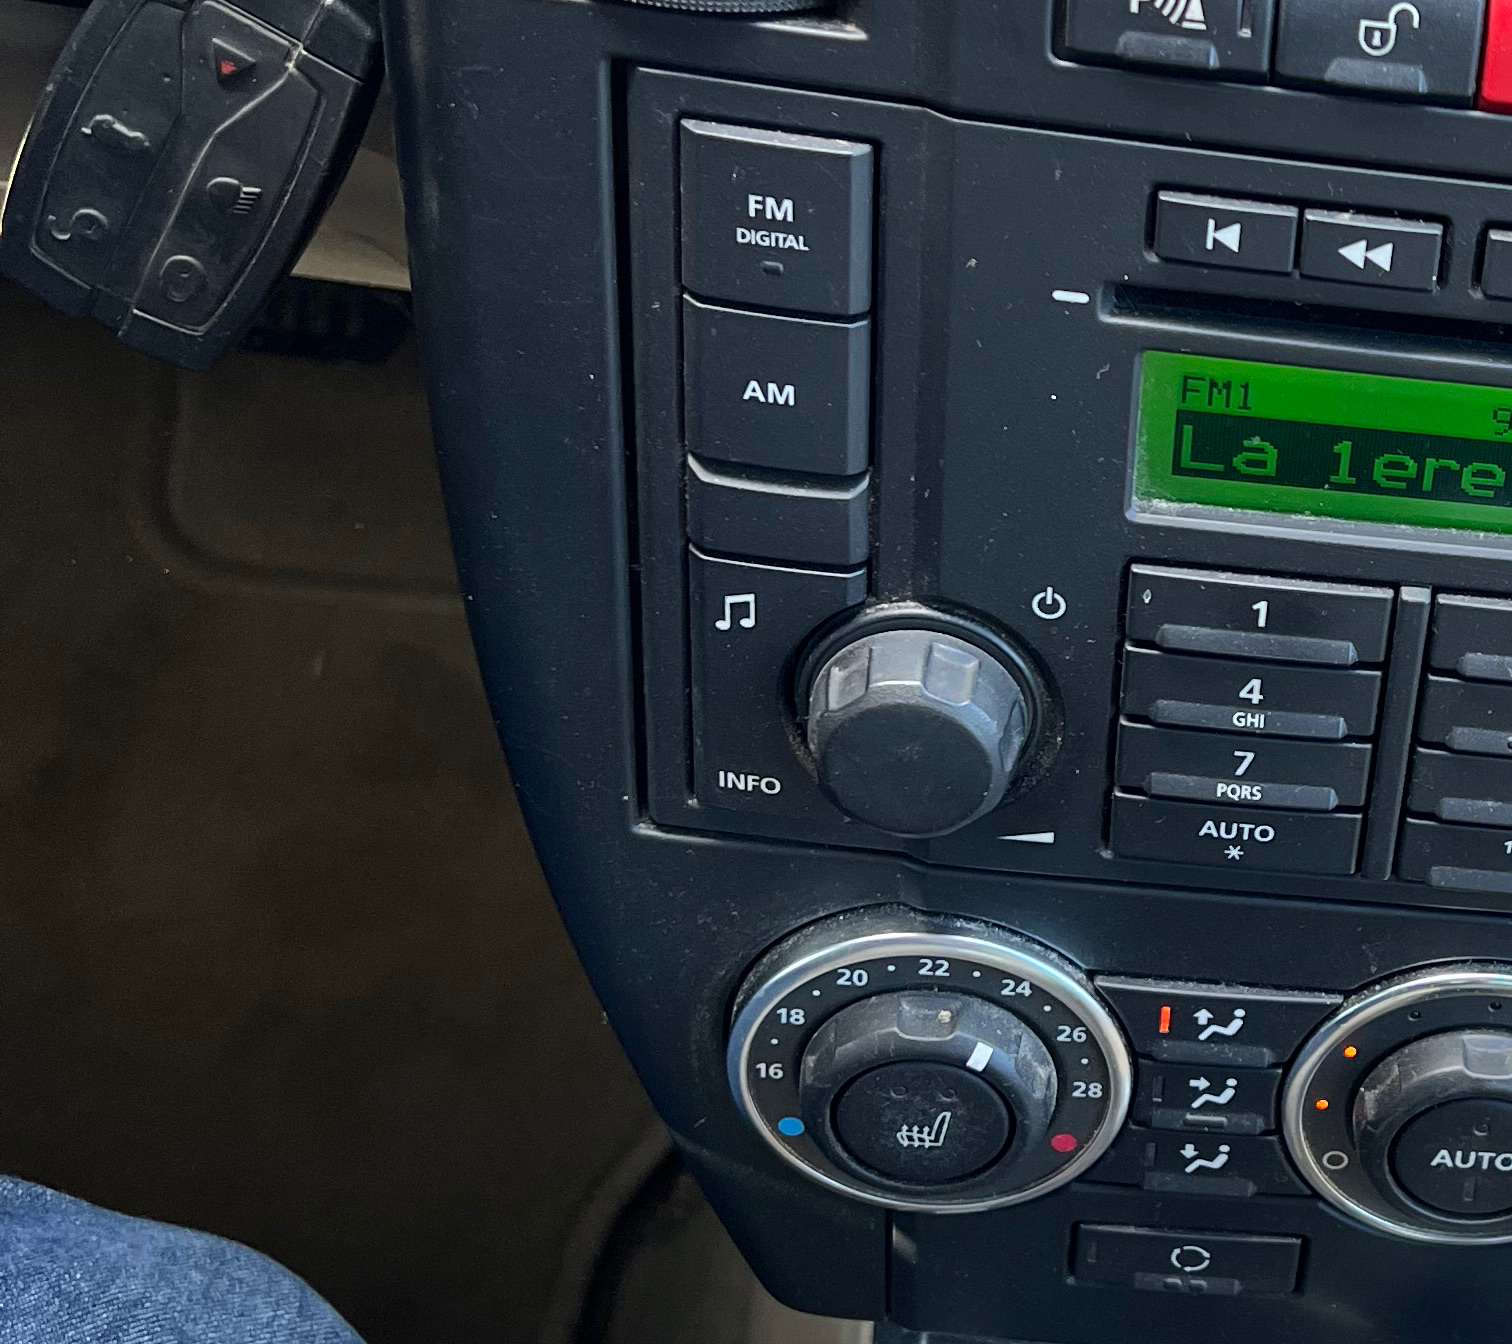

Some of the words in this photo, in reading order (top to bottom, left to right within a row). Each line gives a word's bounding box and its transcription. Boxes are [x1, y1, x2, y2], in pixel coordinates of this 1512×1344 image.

[747, 194, 795, 223] FM
[736, 227, 810, 251] DIGITAL
[742, 380, 796, 406] AM
[1181, 375, 1253, 411] FM1
[1329, 440, 1506, 498] 1ere
[1252, 601, 1268, 628] 1
[1239, 678, 1264, 704] 4
[1232, 712, 1265, 729] GHI
[1233, 750, 1255, 776] 7
[718, 770, 782, 795] INFO
[1216, 783, 1263, 801] PQRS
[1199, 820, 1275, 843] AUTO
[835, 968, 869, 988] 20
[917, 958, 951, 979] 22
[1000, 978, 1033, 999] 24
[776, 1007, 806, 1026] 18
[1057, 1025, 1087, 1044] 26
[755, 1061, 785, 1080] 16
[1071, 1081, 1103, 1099] 28
